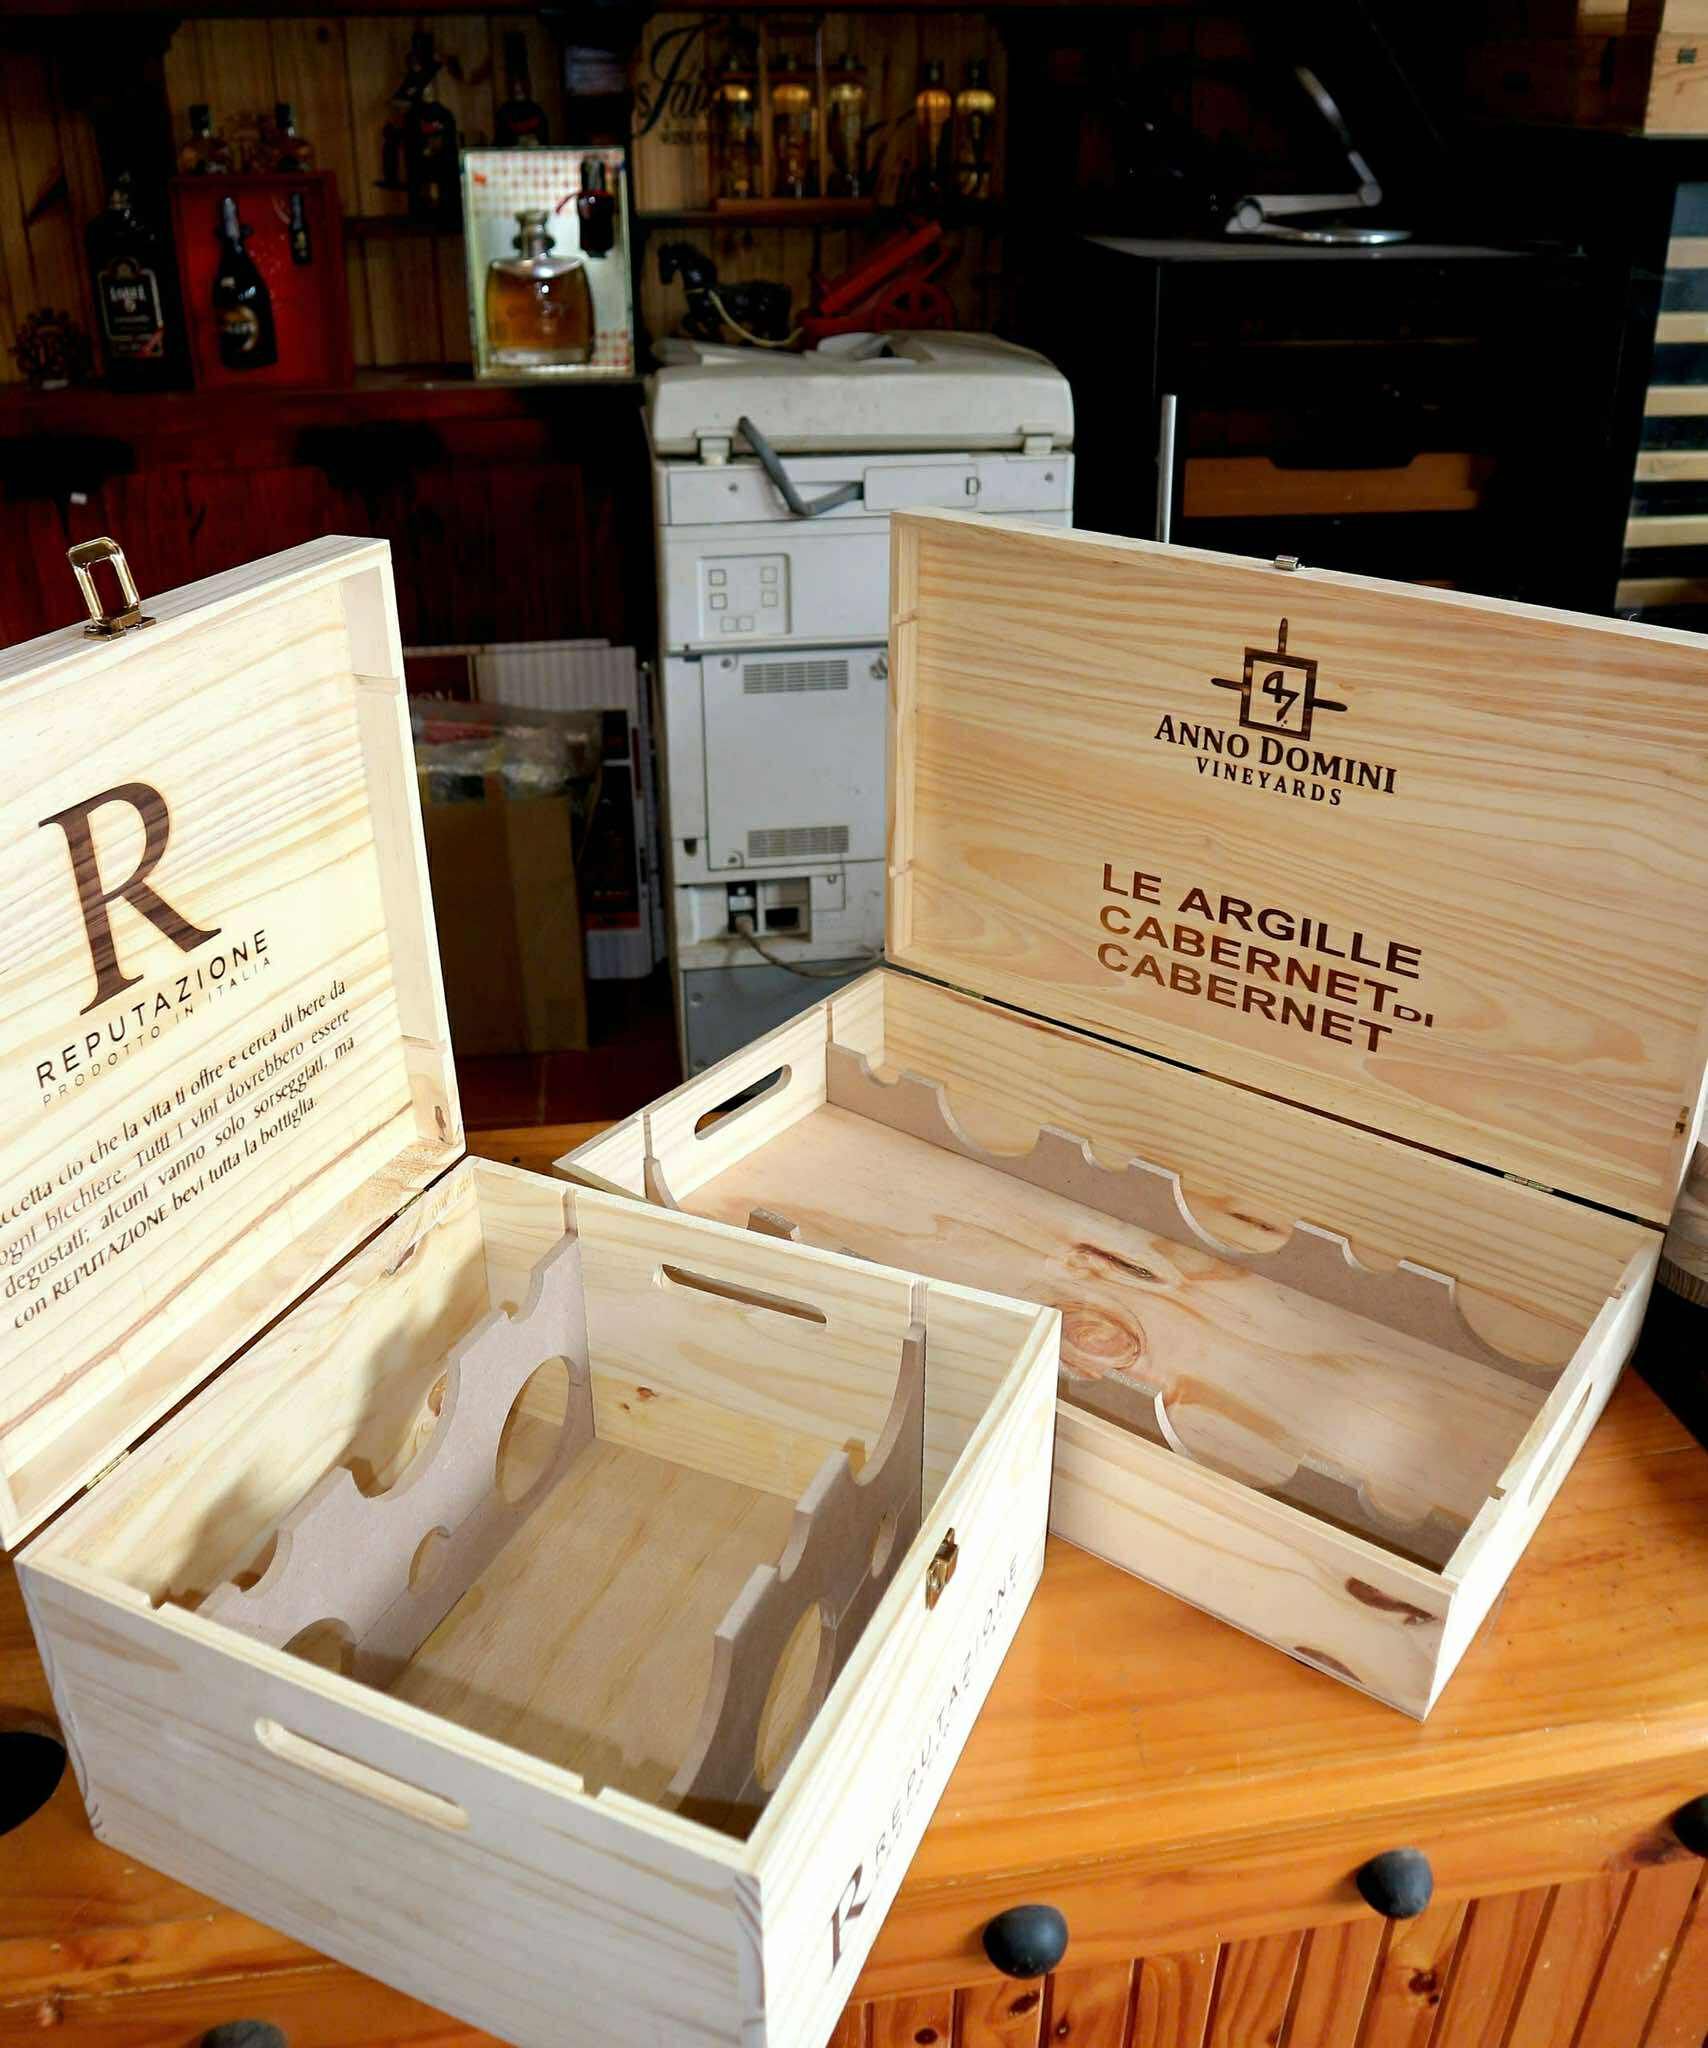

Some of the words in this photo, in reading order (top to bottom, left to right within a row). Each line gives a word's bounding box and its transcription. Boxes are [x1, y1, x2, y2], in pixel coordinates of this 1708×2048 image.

[1153, 714, 1250, 760] ANNO
[1258, 735, 1398, 795] DOMINI
[1262, 671, 1300, 722] 47
[1194, 755, 1342, 806] VINEYARDS
[38, 782, 222, 1016] R
[1099, 904, 1398, 1013] CABERNET
[1393, 1003, 1435, 1028] DI
[1102, 863, 1162, 906] LE
[1177, 886, 1422, 980] ARGILLE
[36, 929, 268, 1089] REPUTAZIONE
[43, 1025, 161, 1108] PRODOTTO
[175, 1005, 194, 1025] IN
[208, 956, 271, 1003] ITALIA
[90, 1136, 118, 1164] che
[123, 1121, 139, 1142] la
[143, 1101, 172, 1127] vita
[175, 1086, 186, 1106] ti
[190, 1064, 224, 1096] offre
[228, 1053, 238, 1071] e
[241, 1028, 277, 1060] cerca
[281, 1013, 294, 1034] di
[297, 994, 326, 1022] bere
[330, 980, 345, 1000] da
[1097, 942, 1393, 1054] CABERNET
[100, 1182, 149, 1230] alcuni
[158, 1145, 206, 1186] vanno
[215, 1116, 246, 1147] solo
[334, 1037, 355, 1060] ma
[134, 1132, 170, 1168] Tutti
[191, 1098, 218, 1128] vini
[226, 1041, 304, 1104] dovrebbero
[311, 1009, 350, 1044] essere
[14, 1297, 48, 1329] con
[52, 1205, 170, 1300] REPUTAZIONE
[171, 1175, 205, 1211] bevi
[208, 1152, 241, 1184] tutta
[244, 1138, 258, 1157] la
